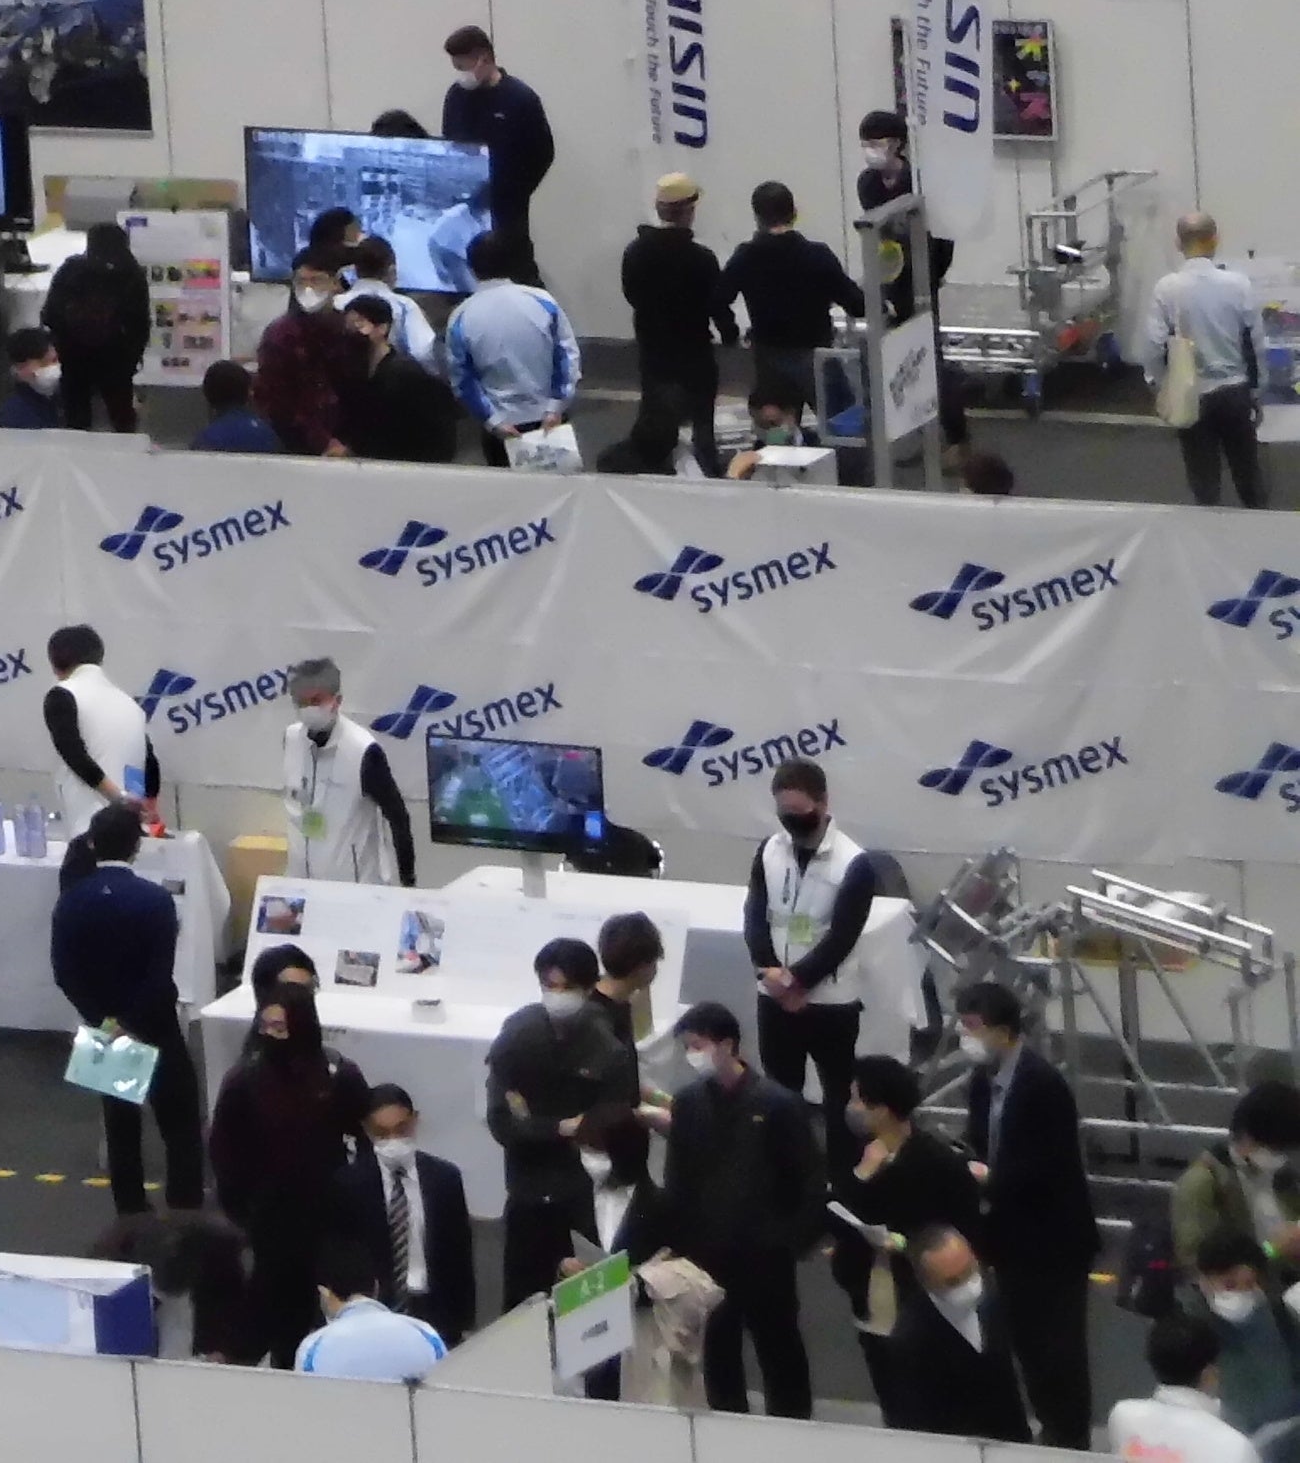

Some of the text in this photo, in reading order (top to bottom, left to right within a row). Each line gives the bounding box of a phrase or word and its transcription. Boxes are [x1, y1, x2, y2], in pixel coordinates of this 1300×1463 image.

[914, 15, 933, 51] the
[914, 56, 932, 126] Future
[153, 496, 293, 573] sysmex
[416, 515, 556, 588] sysmex
[690, 539, 838, 614] sysmex
[971, 557, 1121, 632] sysmex
[166, 662, 298, 736] sysmex
[979, 735, 1130, 808] sysmex
